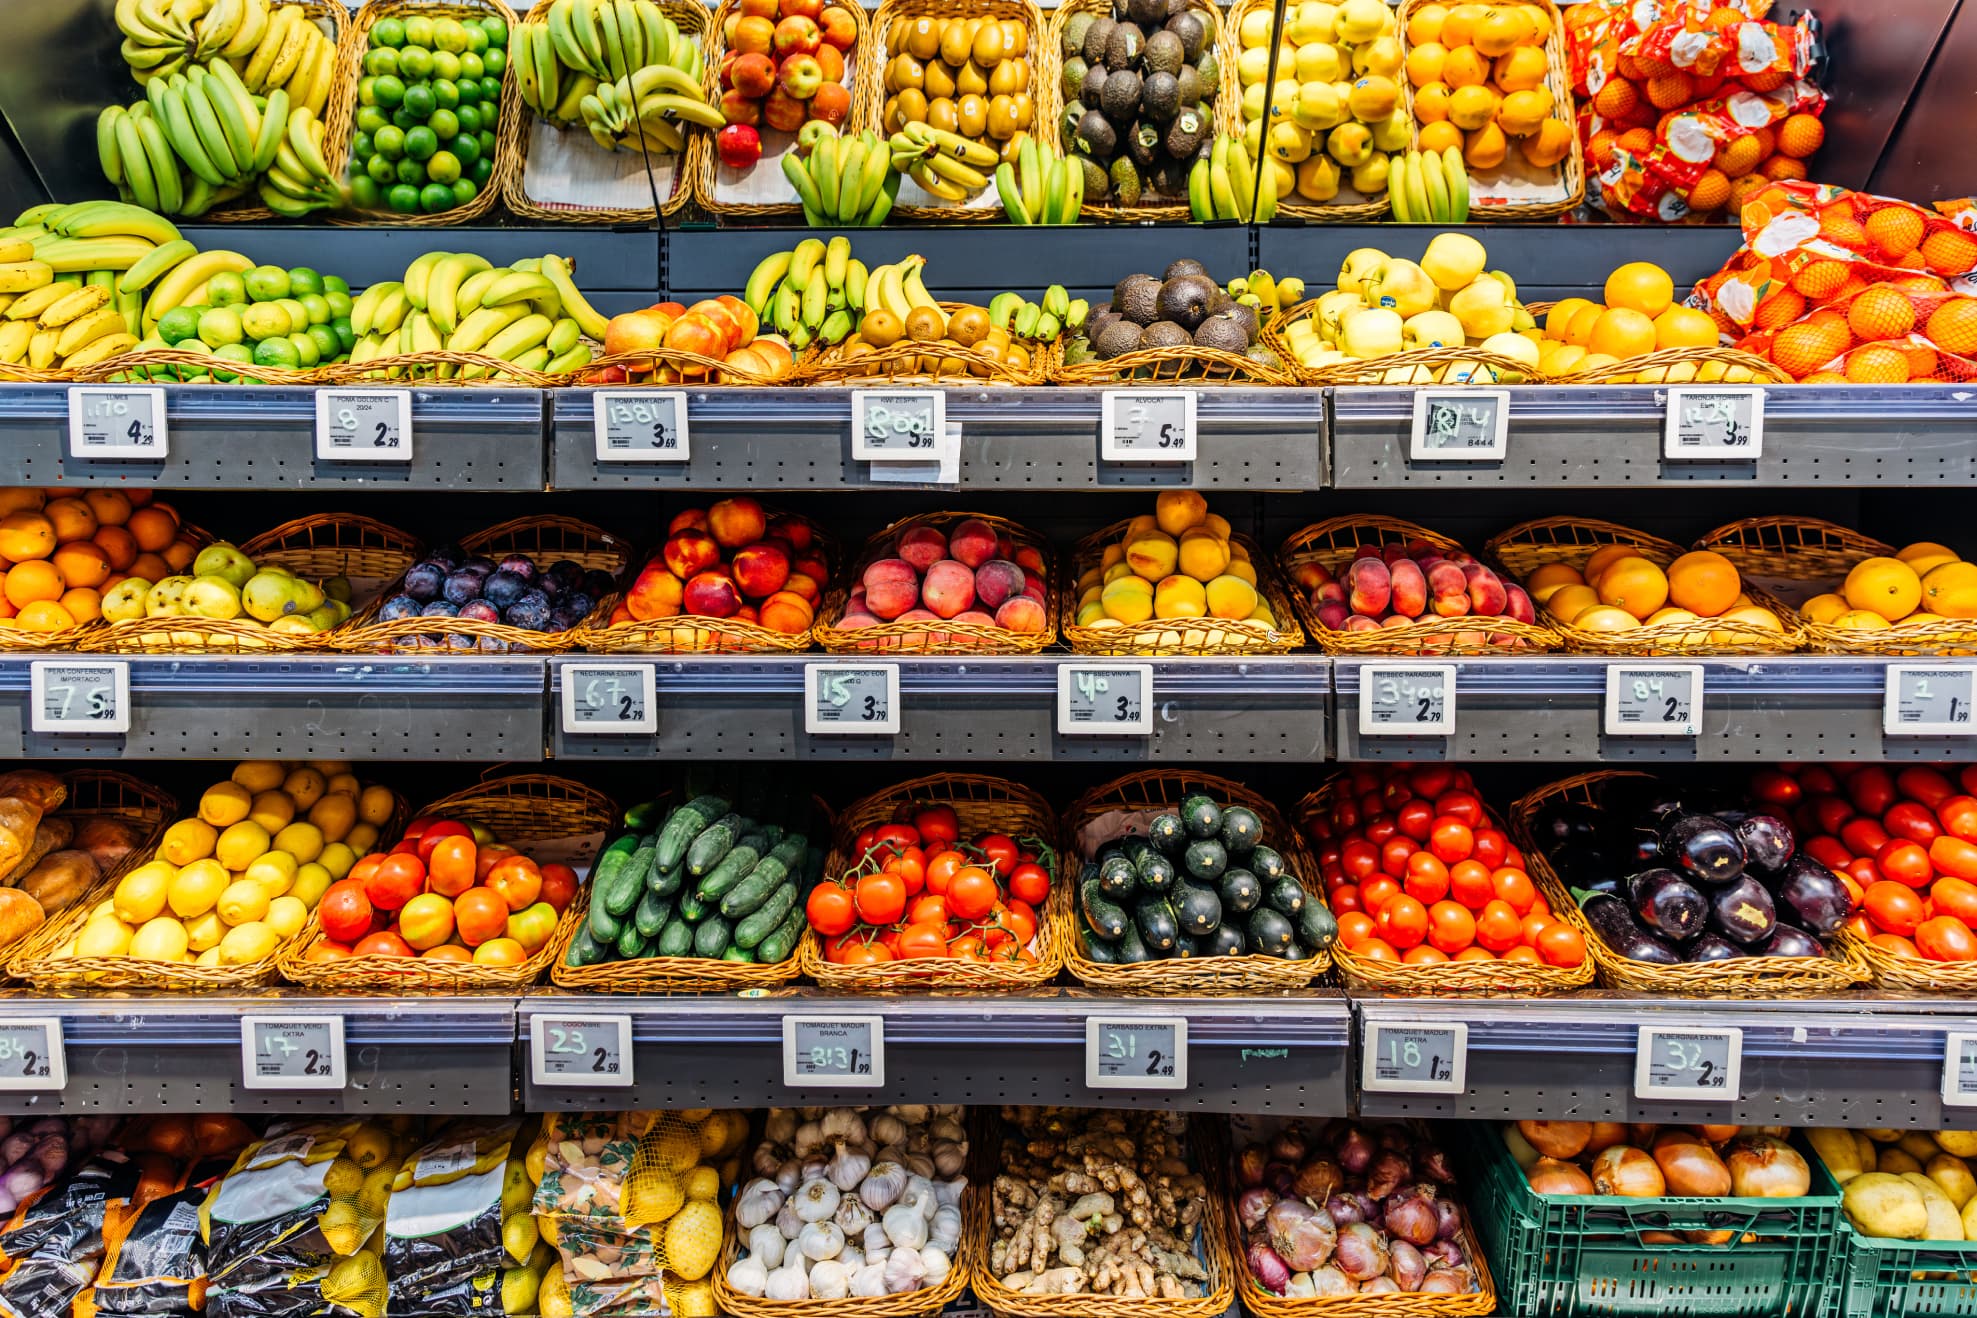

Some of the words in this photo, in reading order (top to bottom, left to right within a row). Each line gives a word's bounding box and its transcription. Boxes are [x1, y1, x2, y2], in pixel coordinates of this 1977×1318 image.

[1468, 439, 1493, 447] 8444
[549, 1029, 587, 1054] 23
[1391, 1040, 1421, 1067] 18
